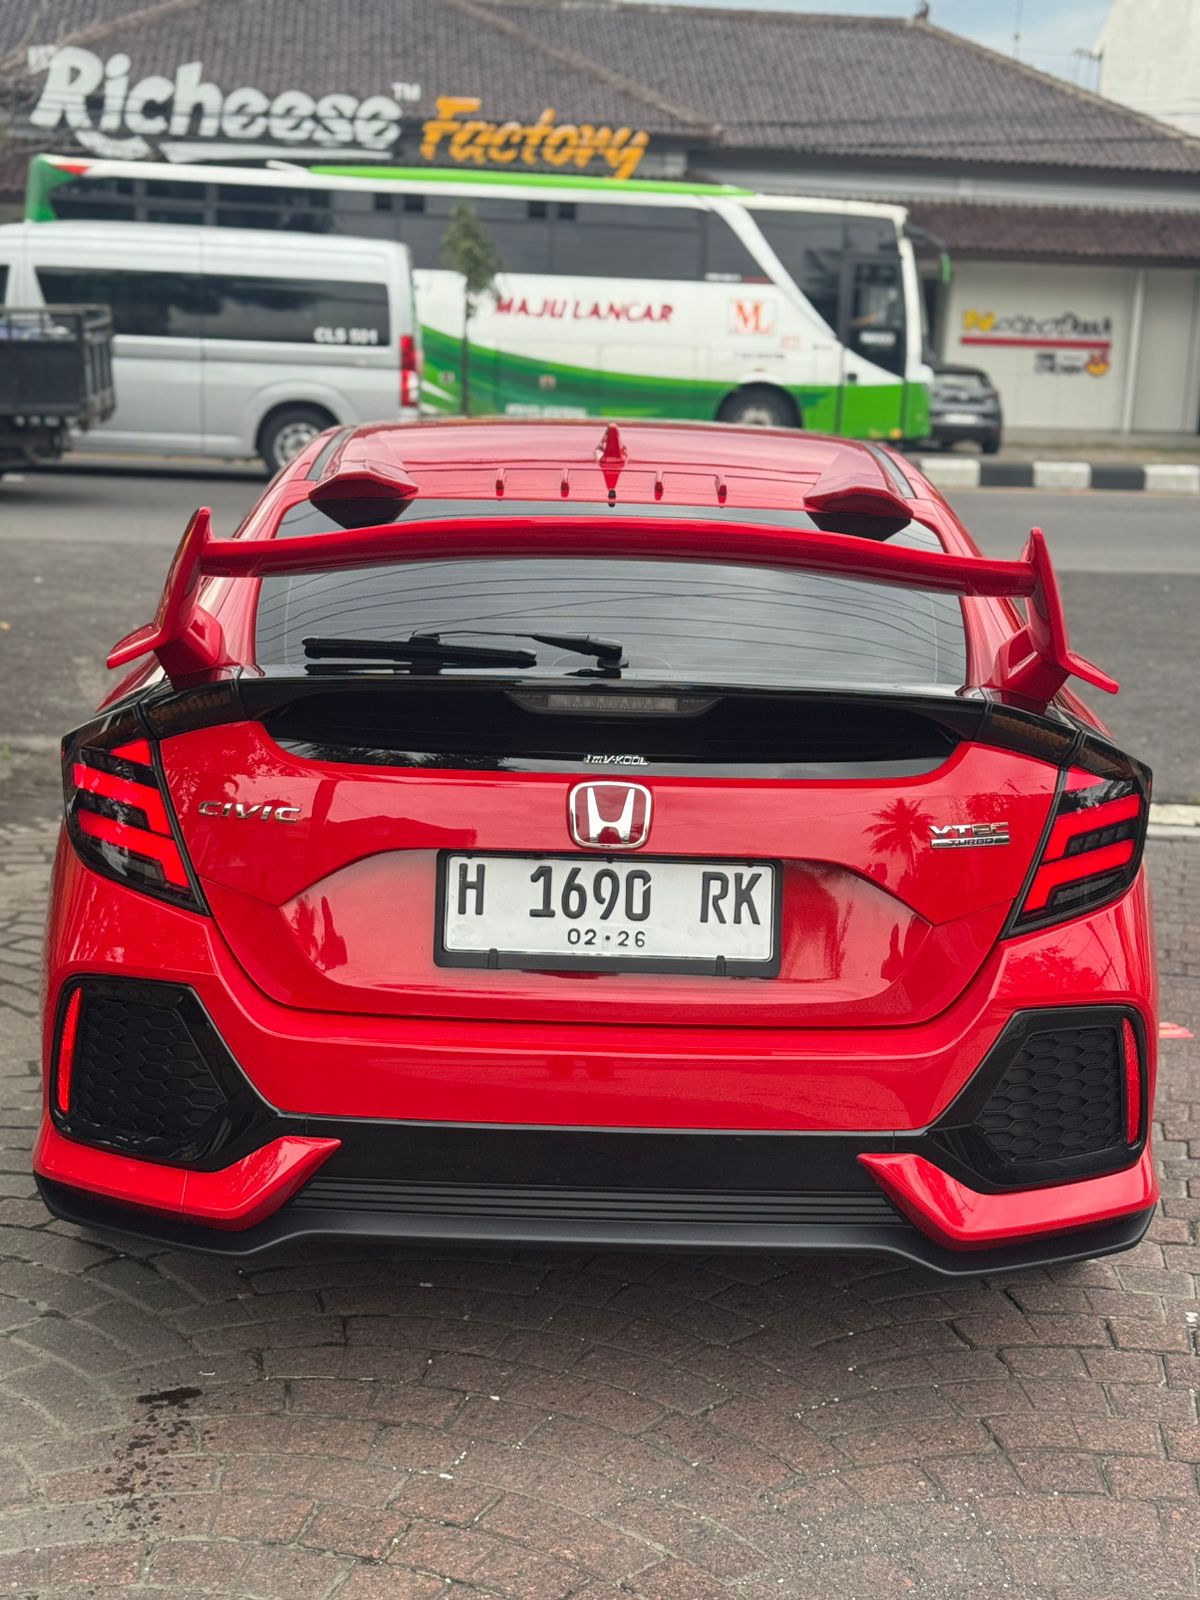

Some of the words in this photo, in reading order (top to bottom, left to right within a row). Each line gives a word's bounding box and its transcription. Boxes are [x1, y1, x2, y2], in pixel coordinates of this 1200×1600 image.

[28, 45, 402, 150] Richeese
[420, 96, 649, 180] Factory
[495, 297, 566, 318] MAJU
[572, 300, 673, 322] LANCAR
[198, 799, 302, 824] CIVIC
[929, 821, 1009, 839] VTEC
[458, 863, 486, 916] H
[529, 865, 652, 922] 1690
[699, 871, 763, 926] RK
